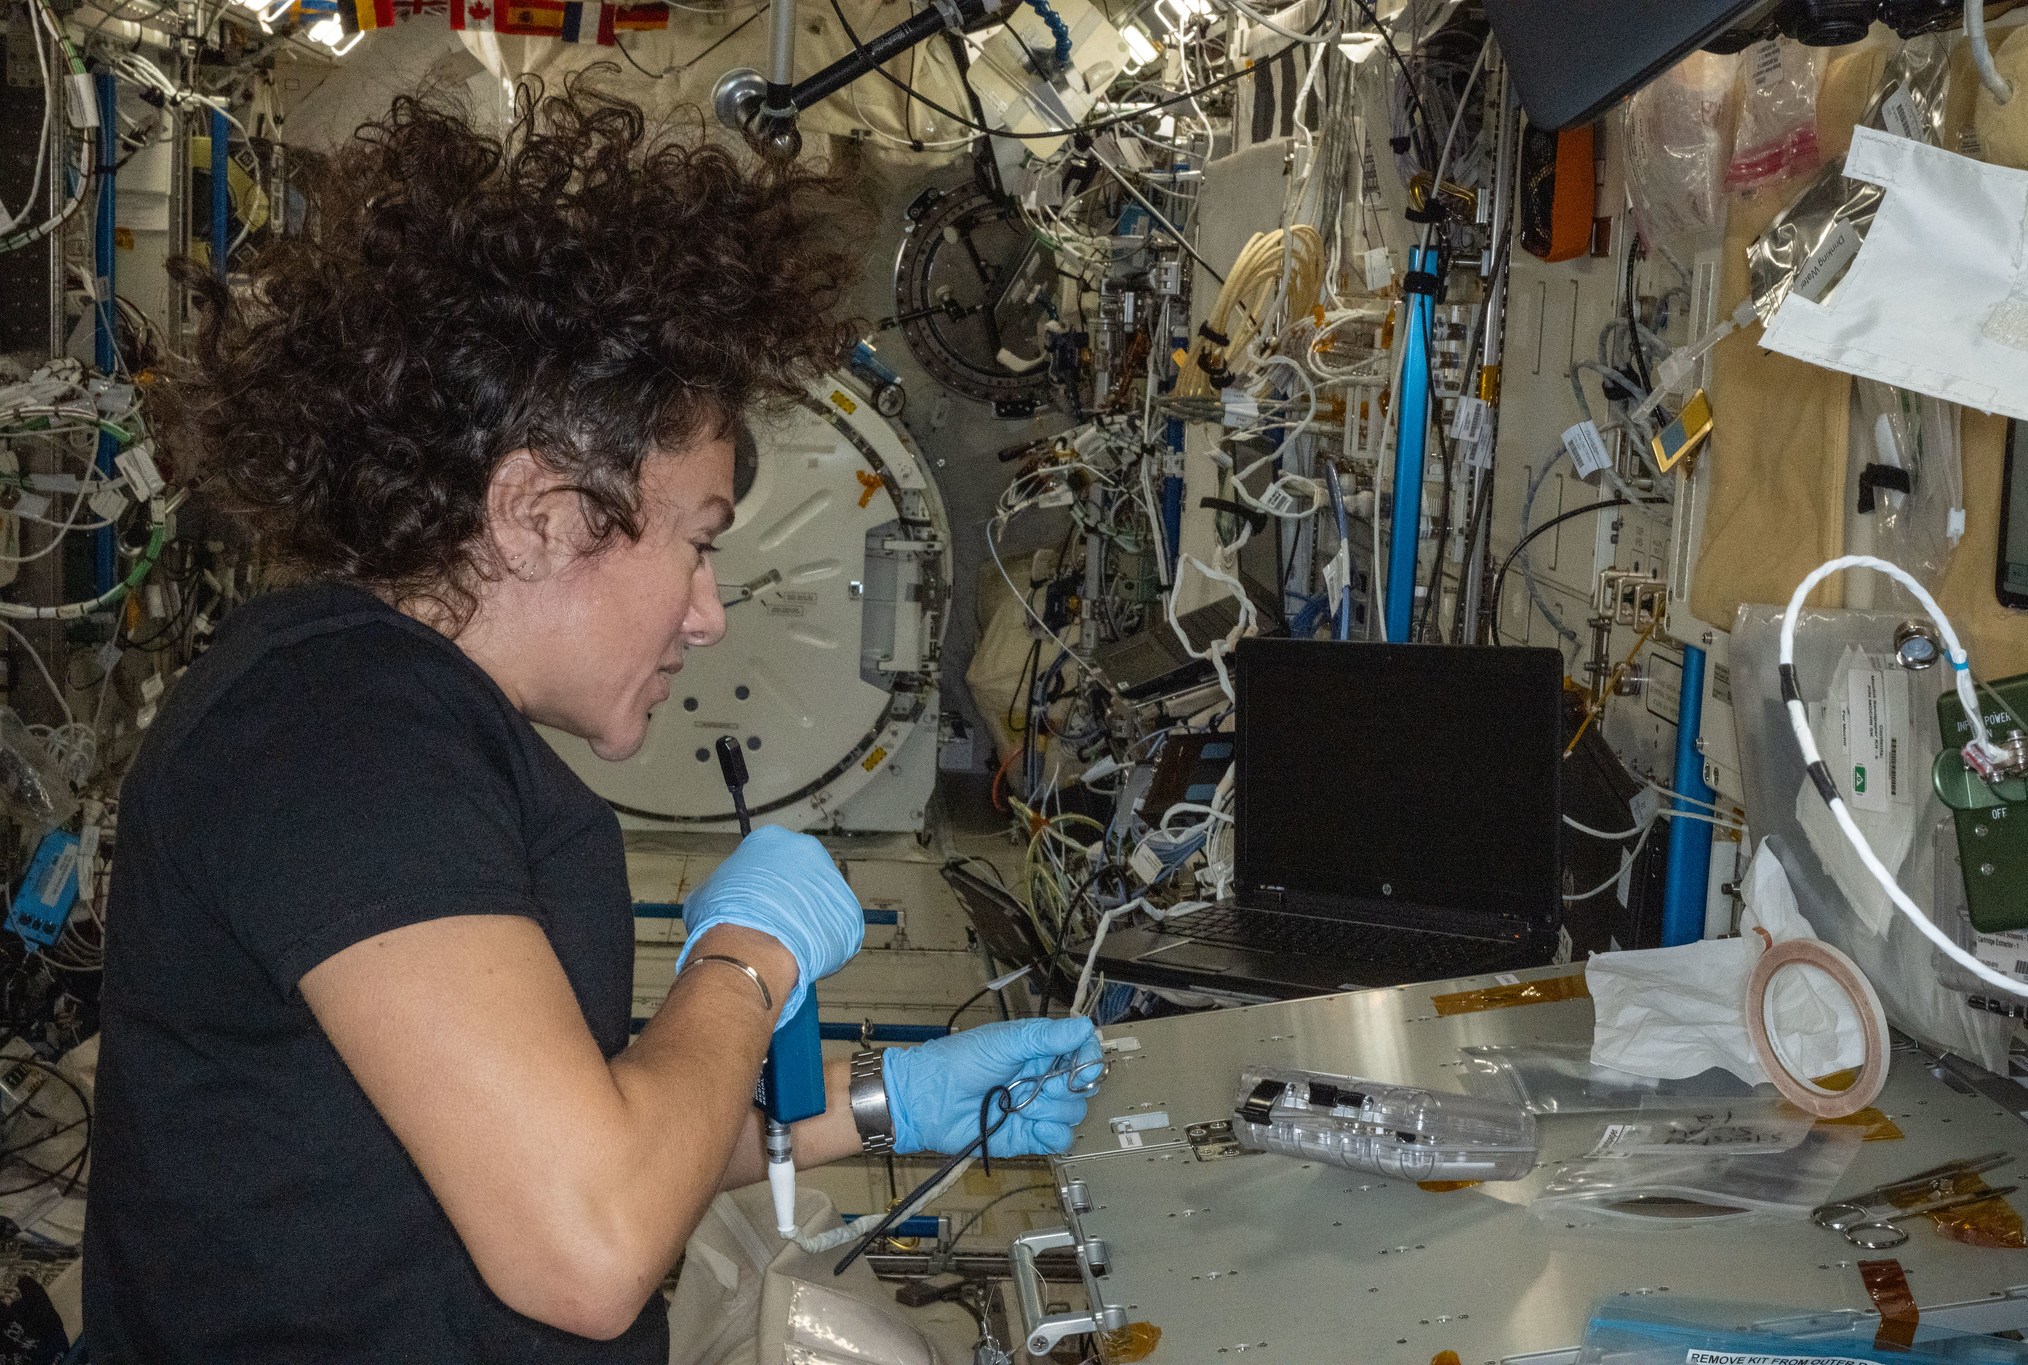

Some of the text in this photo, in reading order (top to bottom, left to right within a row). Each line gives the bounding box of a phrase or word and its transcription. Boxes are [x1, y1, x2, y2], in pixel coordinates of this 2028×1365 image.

[1800, 235, 1845, 291] Drinking Water
[1991, 807, 2007, 820] OFF
[1978, 935, 1995, 946] Cartridge
[1995, 938, 2013, 948] Extractor
[1691, 1353, 1746, 1364] REMOVE
[1748, 1356, 1769, 1364] KIT
